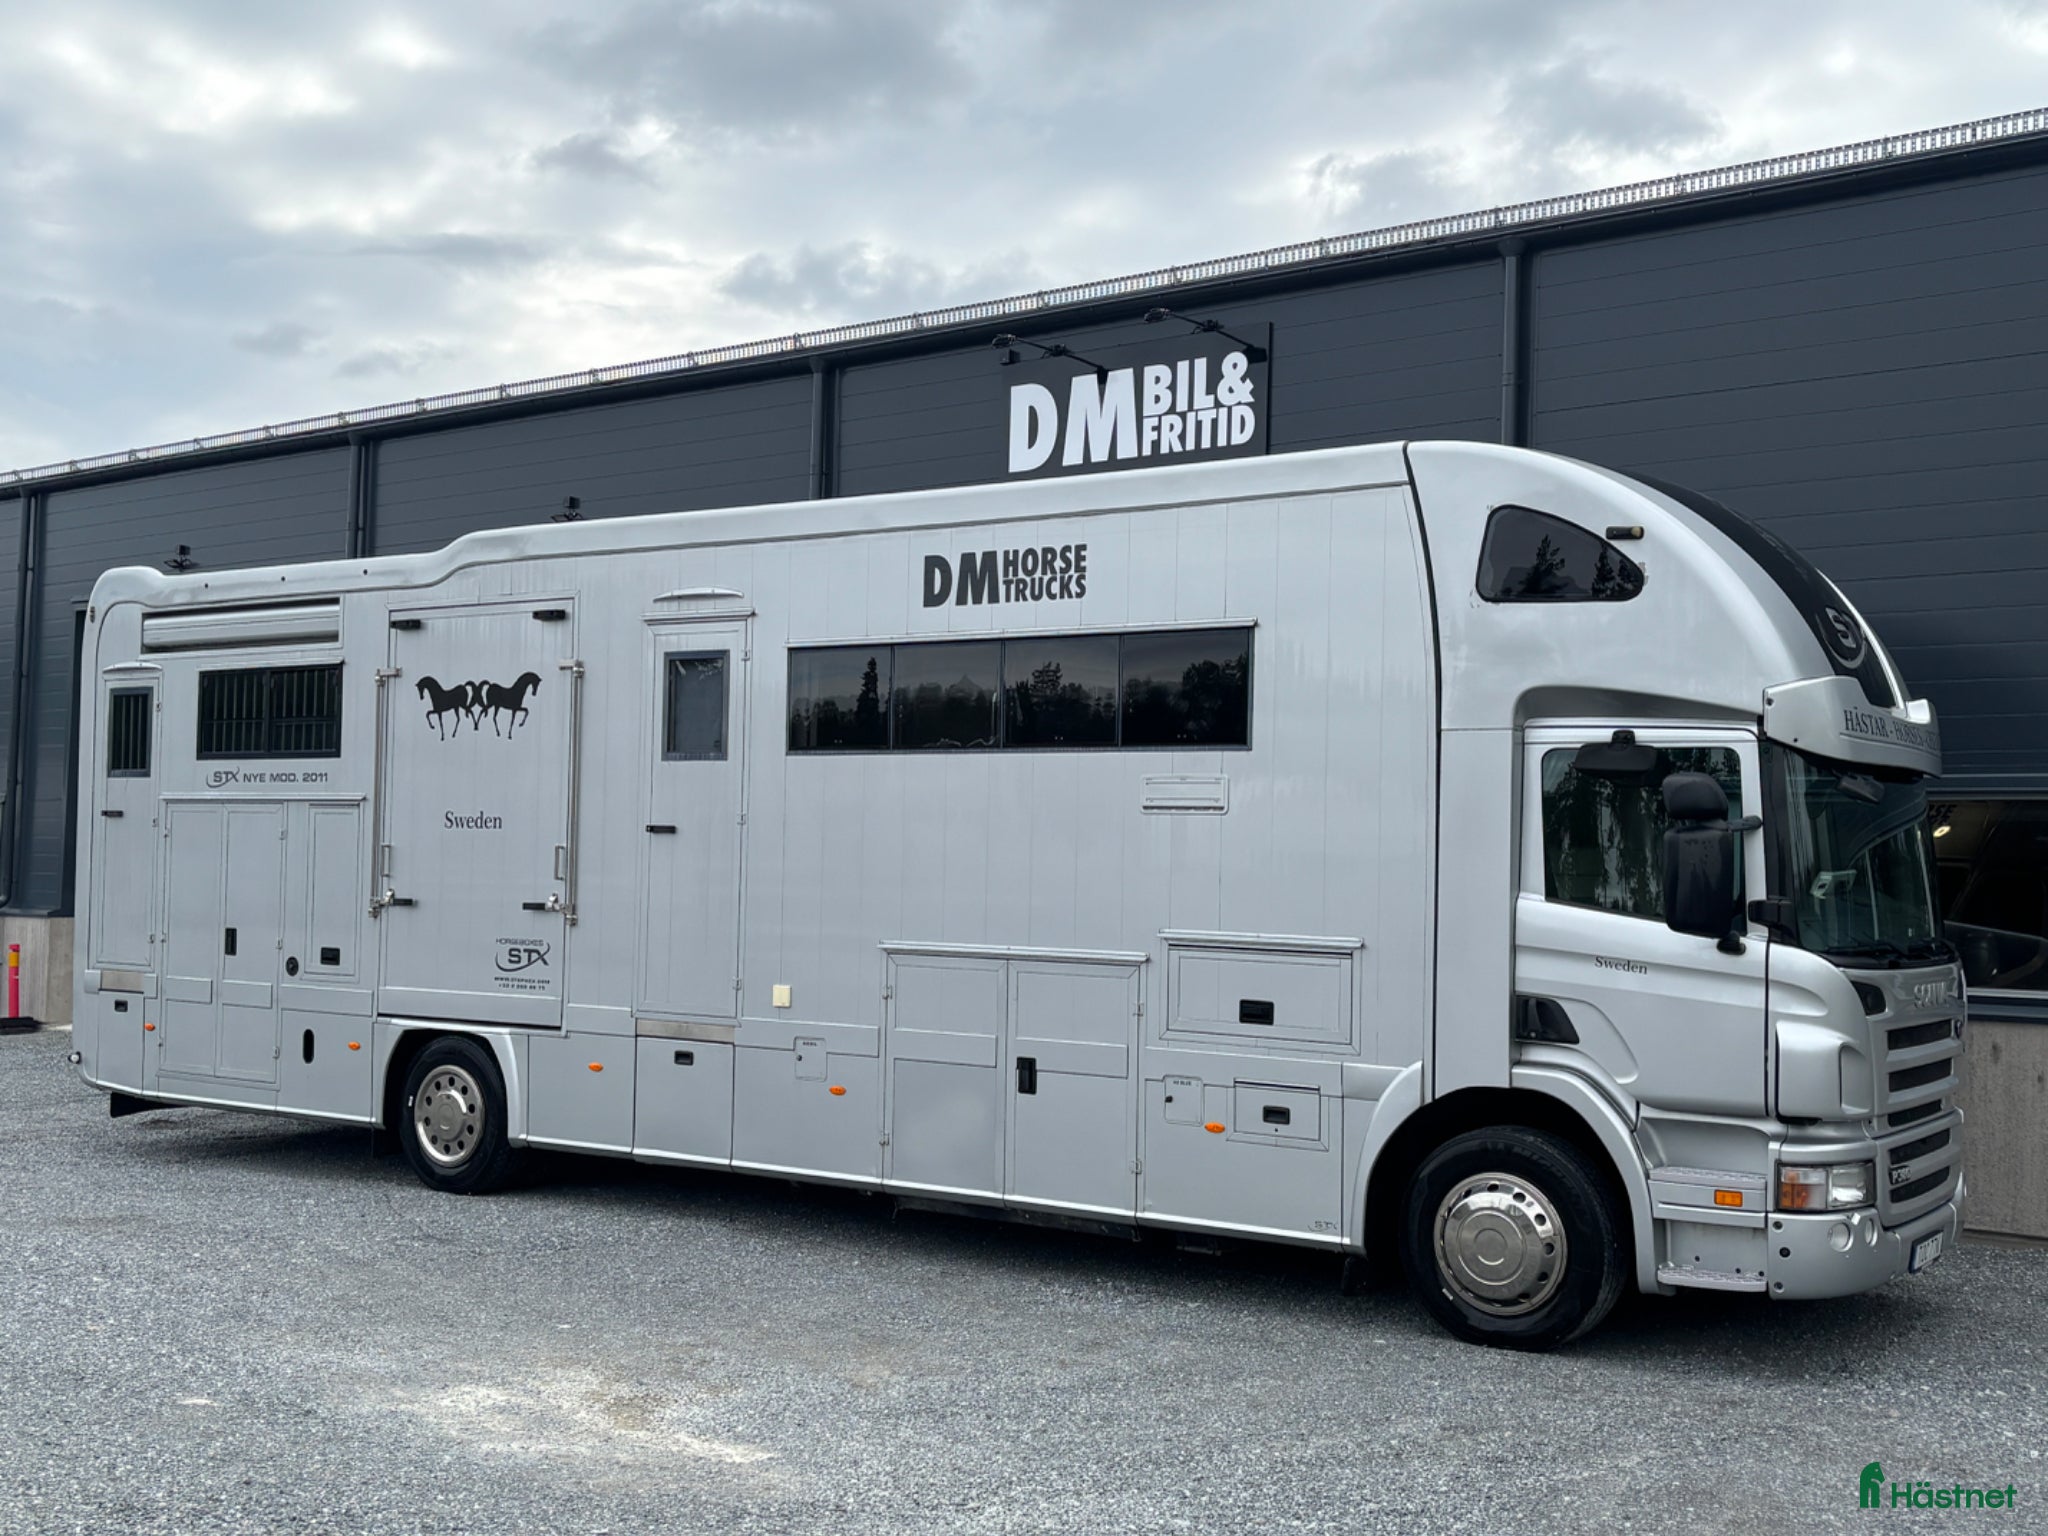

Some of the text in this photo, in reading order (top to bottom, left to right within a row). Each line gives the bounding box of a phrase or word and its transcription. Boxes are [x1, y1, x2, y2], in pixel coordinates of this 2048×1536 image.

[1008, 367, 1139, 473] DM
[1142, 404, 1256, 457] FRITID
[1003, 543, 1088, 579] HORSE
[923, 550, 1001, 608] DM
[1002, 573, 1087, 603] TRUCKS
[211, 766, 241, 785] STX
[243, 773, 267, 783] NYE
[302, 772, 329, 783] 2011
[444, 810, 503, 830] Sweden
[502, 942, 551, 969] STX
[1594, 955, 1648, 975] Sweden
